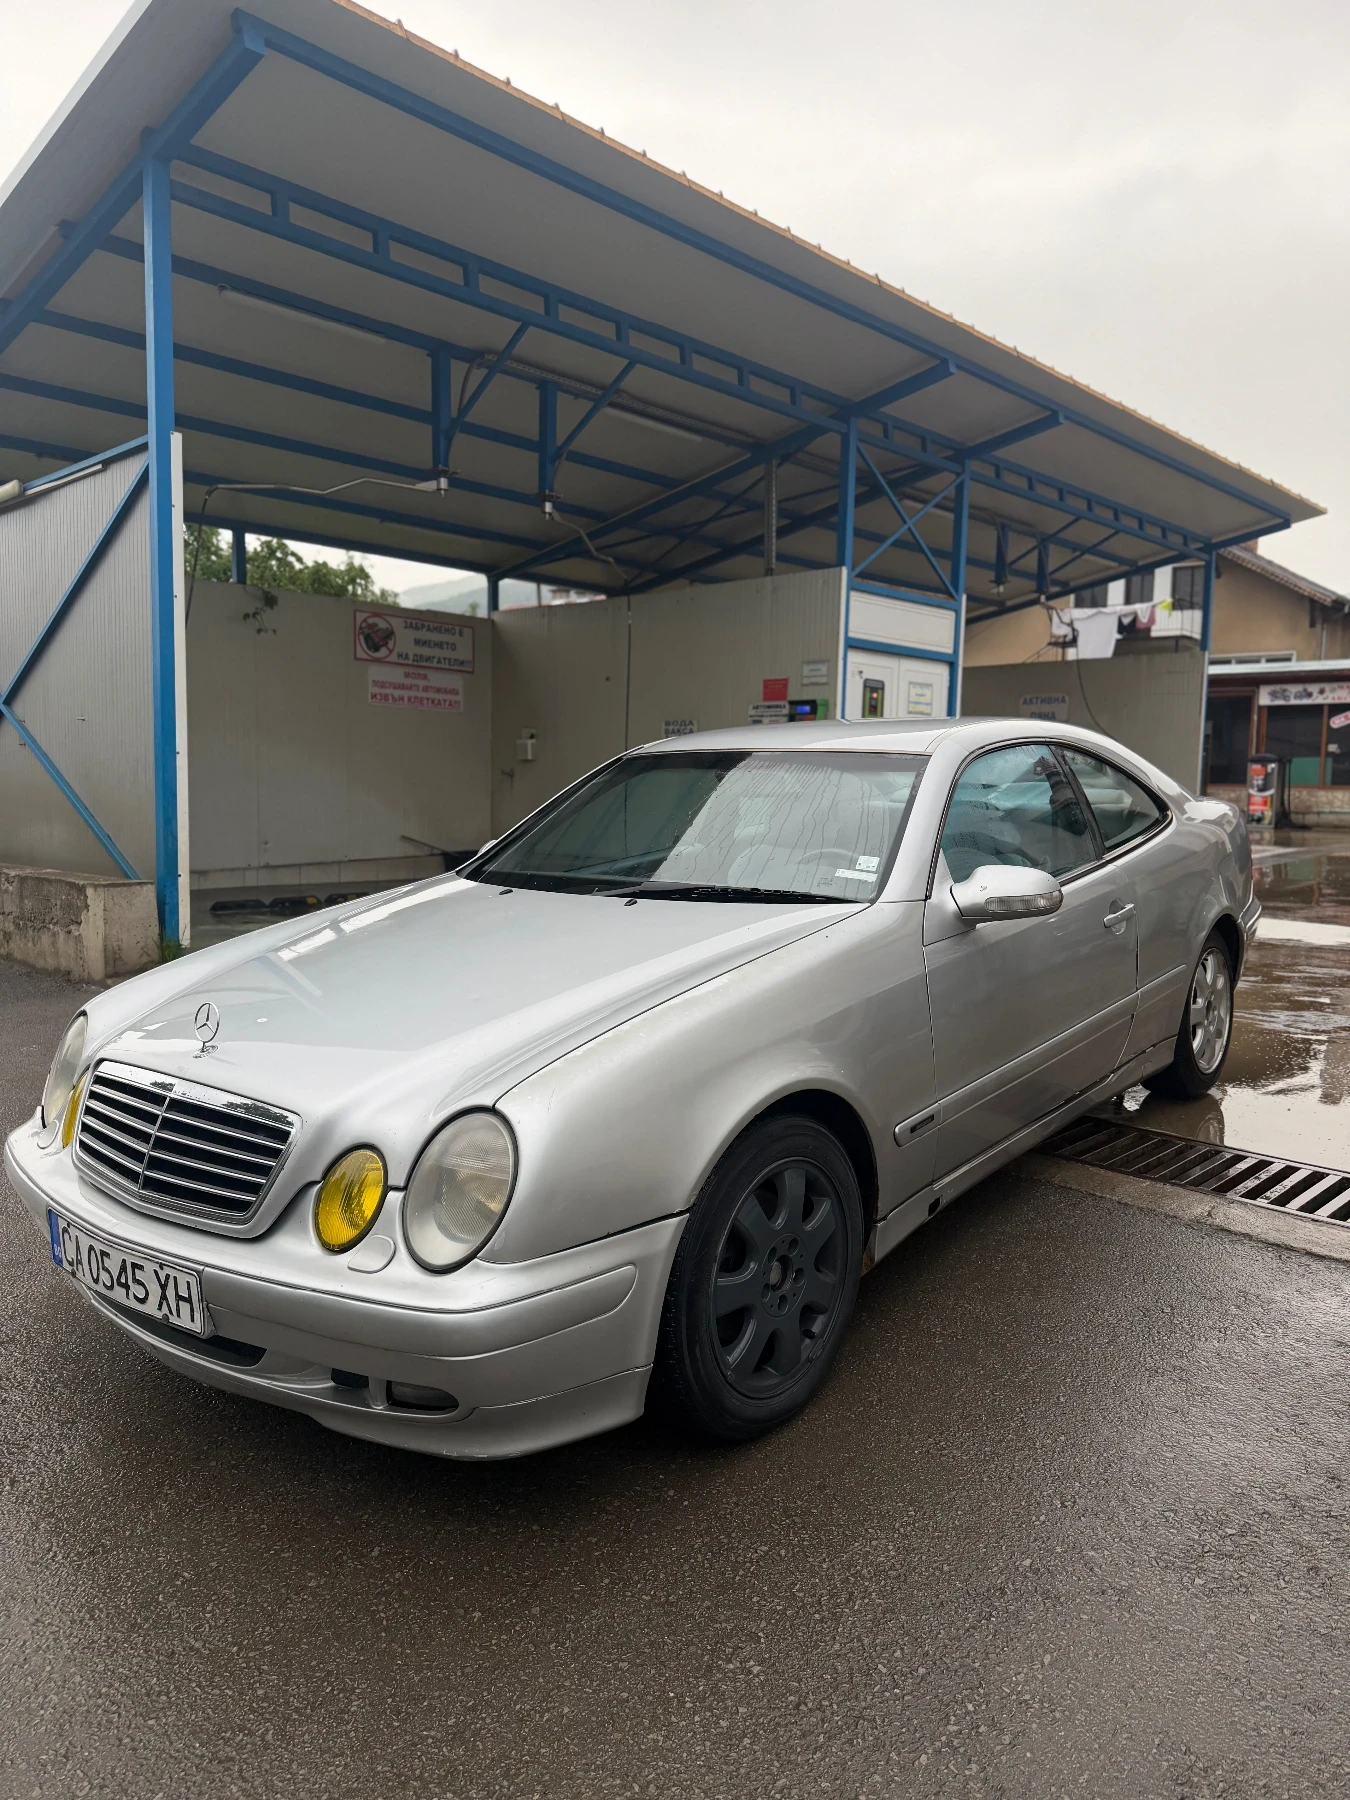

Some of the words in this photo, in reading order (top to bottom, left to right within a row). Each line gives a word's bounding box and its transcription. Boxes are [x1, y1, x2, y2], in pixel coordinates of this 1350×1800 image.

[403, 620, 456, 636] ЗАБРАНЕНО
[458, 627, 464, 637] Е
[414, 637, 456, 651] МИЕНЕТО
[397, 651, 410, 661] НА
[371, 692, 404, 703] ИЗВЪН
[1022, 695, 1066, 706] АКТИВНА
[664, 719, 694, 727] ВОДА
[664, 727, 694, 736] ВАКСА
[61, 1226, 86, 1278] CA
[88, 1243, 149, 1304] 0545
[153, 1268, 195, 1323] XH
